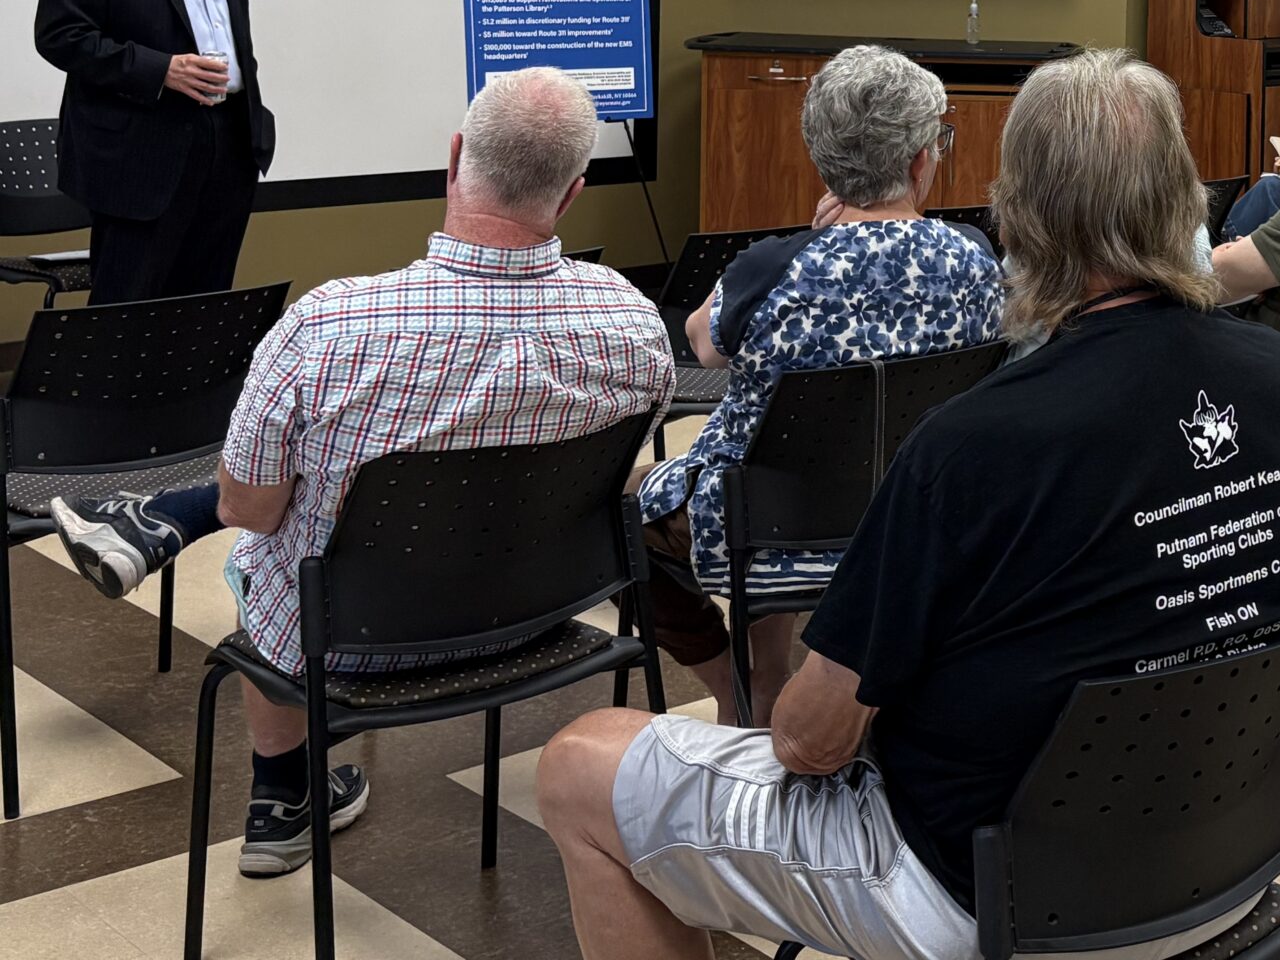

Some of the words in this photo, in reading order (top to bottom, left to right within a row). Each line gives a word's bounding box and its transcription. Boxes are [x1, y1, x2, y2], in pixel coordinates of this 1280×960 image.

[567, 16, 591, 25] funding
[1134, 490, 1212, 527] Councilman
[1214, 476, 1255, 501] Robert
[1156, 532, 1208, 558] Putnam
[1210, 507, 1274, 541] Federation
[1182, 540, 1235, 569] Sporting
[1238, 527, 1274, 550] Clubs
[1155, 588, 1195, 611] Oasis
[1198, 566, 1268, 600] Sportmens
[1205, 612, 1236, 632] Fish
[1238, 602, 1259, 621] ON
[1135, 649, 1189, 674] Carmel
[1193, 644, 1218, 658] P.D.
[1223, 634, 1248, 648] P.O.
